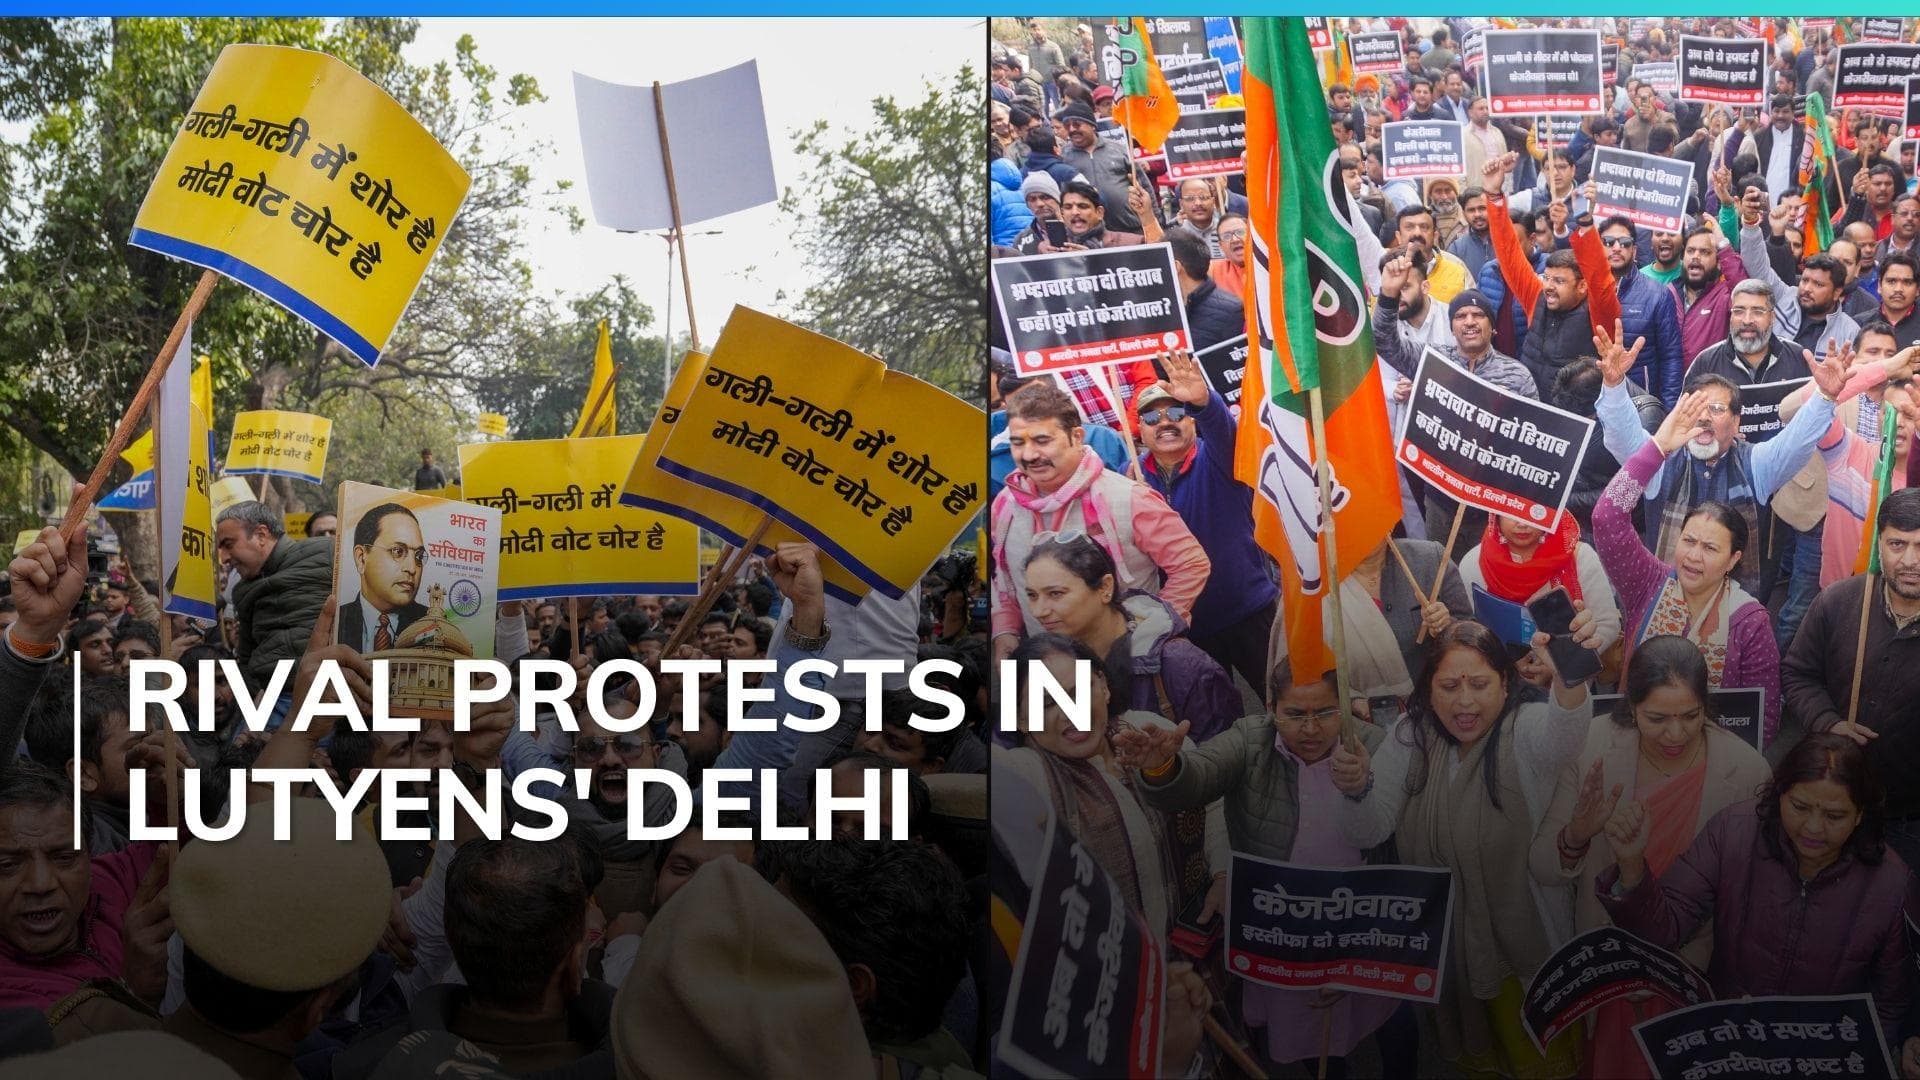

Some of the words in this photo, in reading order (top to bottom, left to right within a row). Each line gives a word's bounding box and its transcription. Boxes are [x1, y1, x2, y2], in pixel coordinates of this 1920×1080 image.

[1687, 49, 1702, 61] अब
[1704, 48, 1714, 63] तो
[1716, 49, 1724, 63] ये
[1751, 48, 1759, 65] है
[184, 104, 310, 158] गली-गली
[311, 143, 358, 181] में
[350, 171, 411, 230] शोर
[407, 217, 436, 255] है
[178, 159, 233, 198] मोदी
[232, 172, 290, 217] वोट
[290, 200, 353, 257] चोर
[350, 241, 382, 281] है
[1010, 277, 1075, 301] भ्रष्टाचार
[1075, 276, 1099, 294] का
[1100, 268, 1118, 290] दो
[1116, 267, 1163, 289] हिसाब
[1017, 309, 1051, 333] कहाँ
[1051, 307, 1076, 335] छुपे
[1077, 304, 1095, 327] हो
[1425, 378, 1477, 422] भ्रष्टाचार
[1476, 406, 1500, 433] का
[1499, 416, 1521, 440] दो
[1518, 421, 1570, 458] हिसाब
[705, 367, 853, 443] गली-गली
[853, 429, 896, 459] में
[887, 451, 949, 495] शोर
[942, 482, 978, 515] है
[1416, 410, 1442, 438] कहाँ
[1438, 427, 1461, 451] छुपे
[1460, 438, 1478, 460] हो
[712, 419, 780, 458] मोदी
[781, 449, 834, 485] वोट
[834, 474, 886, 517] चोर
[881, 505, 912, 536] है
[590, 483, 617, 509] में
[450, 513, 487, 532] भारत
[550, 526, 592, 551] वोट
[598, 524, 641, 549] चोर
[646, 522, 666, 550] है
[428, 540, 485, 565] संविधान
[473, 536, 486, 547] का
[1252, 883, 1426, 922] केजरीवाल
[1241, 925, 1309, 949] इस्तीफा
[1312, 931, 1334, 949] दो
[1337, 928, 1406, 949] इस्तीफा
[1408, 932, 1430, 950] दो
[1665, 1029, 1709, 1056] अब
[1709, 1018, 1745, 1043] तो
[1746, 1018, 1769, 1042] ये
[1768, 1022, 1833, 1042] स्पष्ट
[1836, 1014, 1862, 1042] है
[1681, 1050, 1791, 1080] केजरीवाल
[1795, 1056, 1842, 1079] भ्रष्ट
[1844, 1051, 1865, 1074] है
